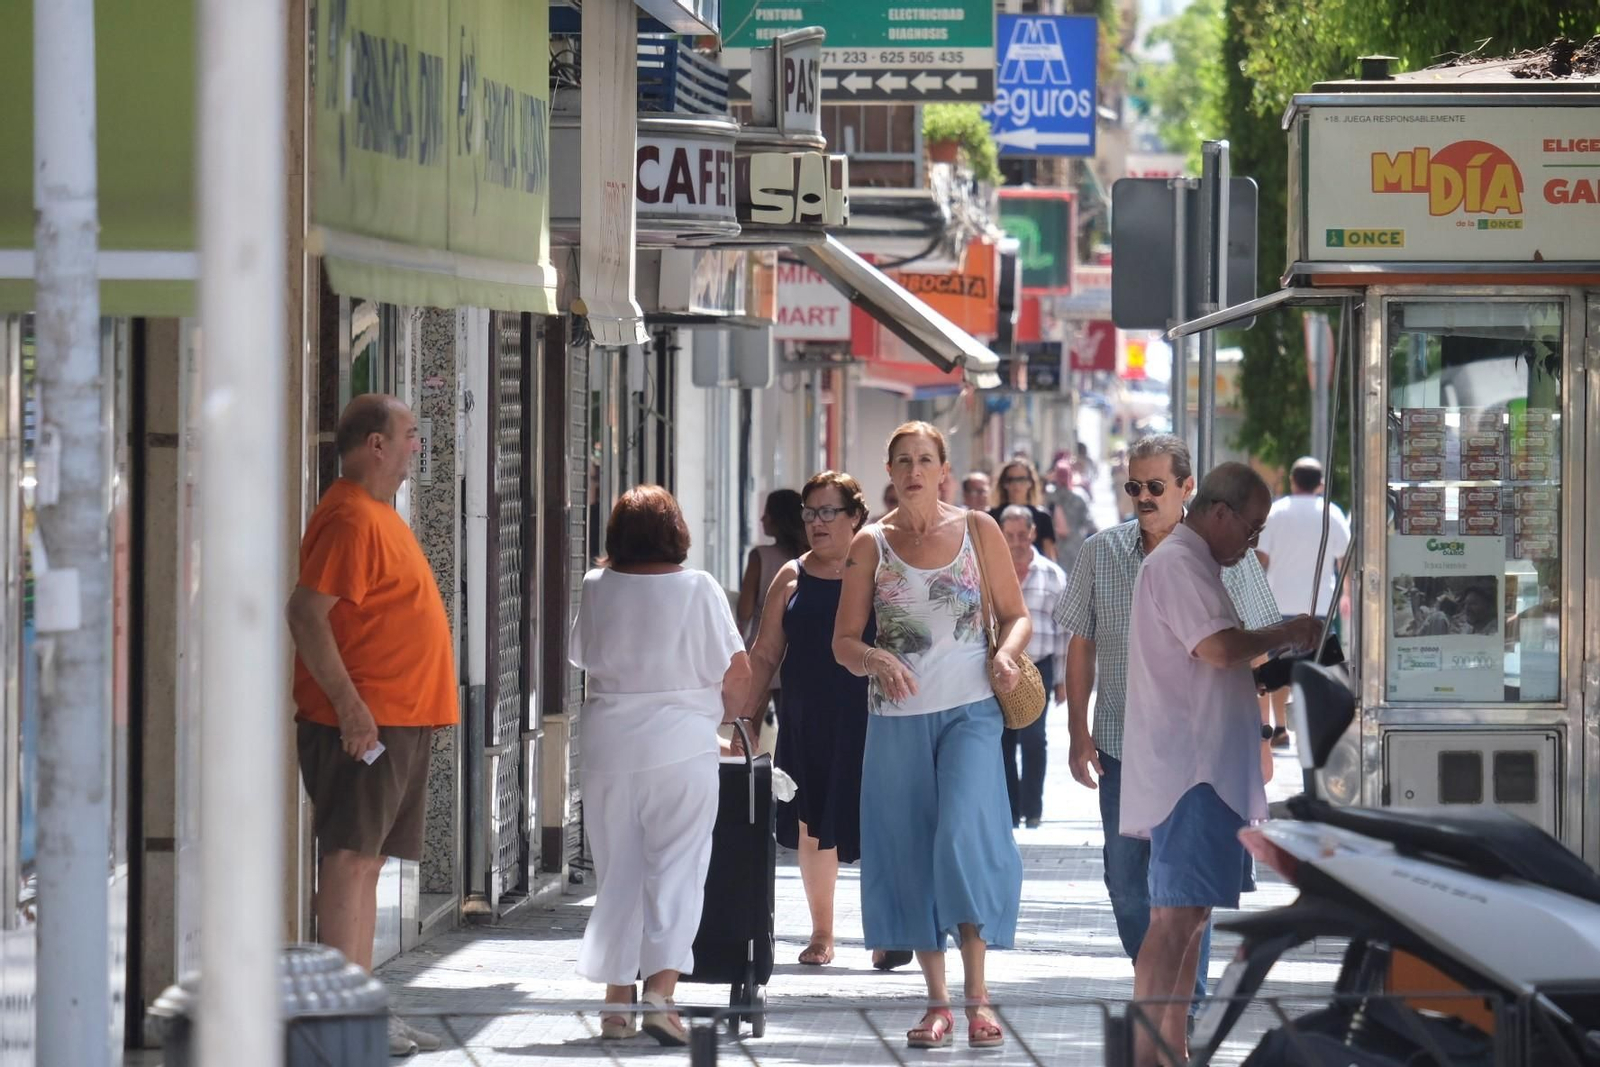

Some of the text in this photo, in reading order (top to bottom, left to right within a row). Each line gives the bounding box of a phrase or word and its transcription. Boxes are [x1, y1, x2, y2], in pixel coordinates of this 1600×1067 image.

[755, 9, 802, 20] PINTURA
[888, 9, 964, 20] ELECTRICIDAD
[756, 27, 799, 40] NEUM
[888, 28, 948, 40] DIAGNOSIS
[822, 51, 964, 63] 71 233 625 505 435
[1343, 115, 1371, 124] JUEGA
[1373, 115, 1465, 123] RESPONSABLEMENTE
[1543, 139, 1600, 152] ELIGE
[1371, 147, 1523, 216] MI DÍA
[1543, 178, 1600, 205] GA
[1456, 219, 1521, 228] de la ONCE
[1348, 231, 1401, 245] ONCE
[777, 264, 834, 283] MIN
[898, 272, 986, 298] BOCATA
